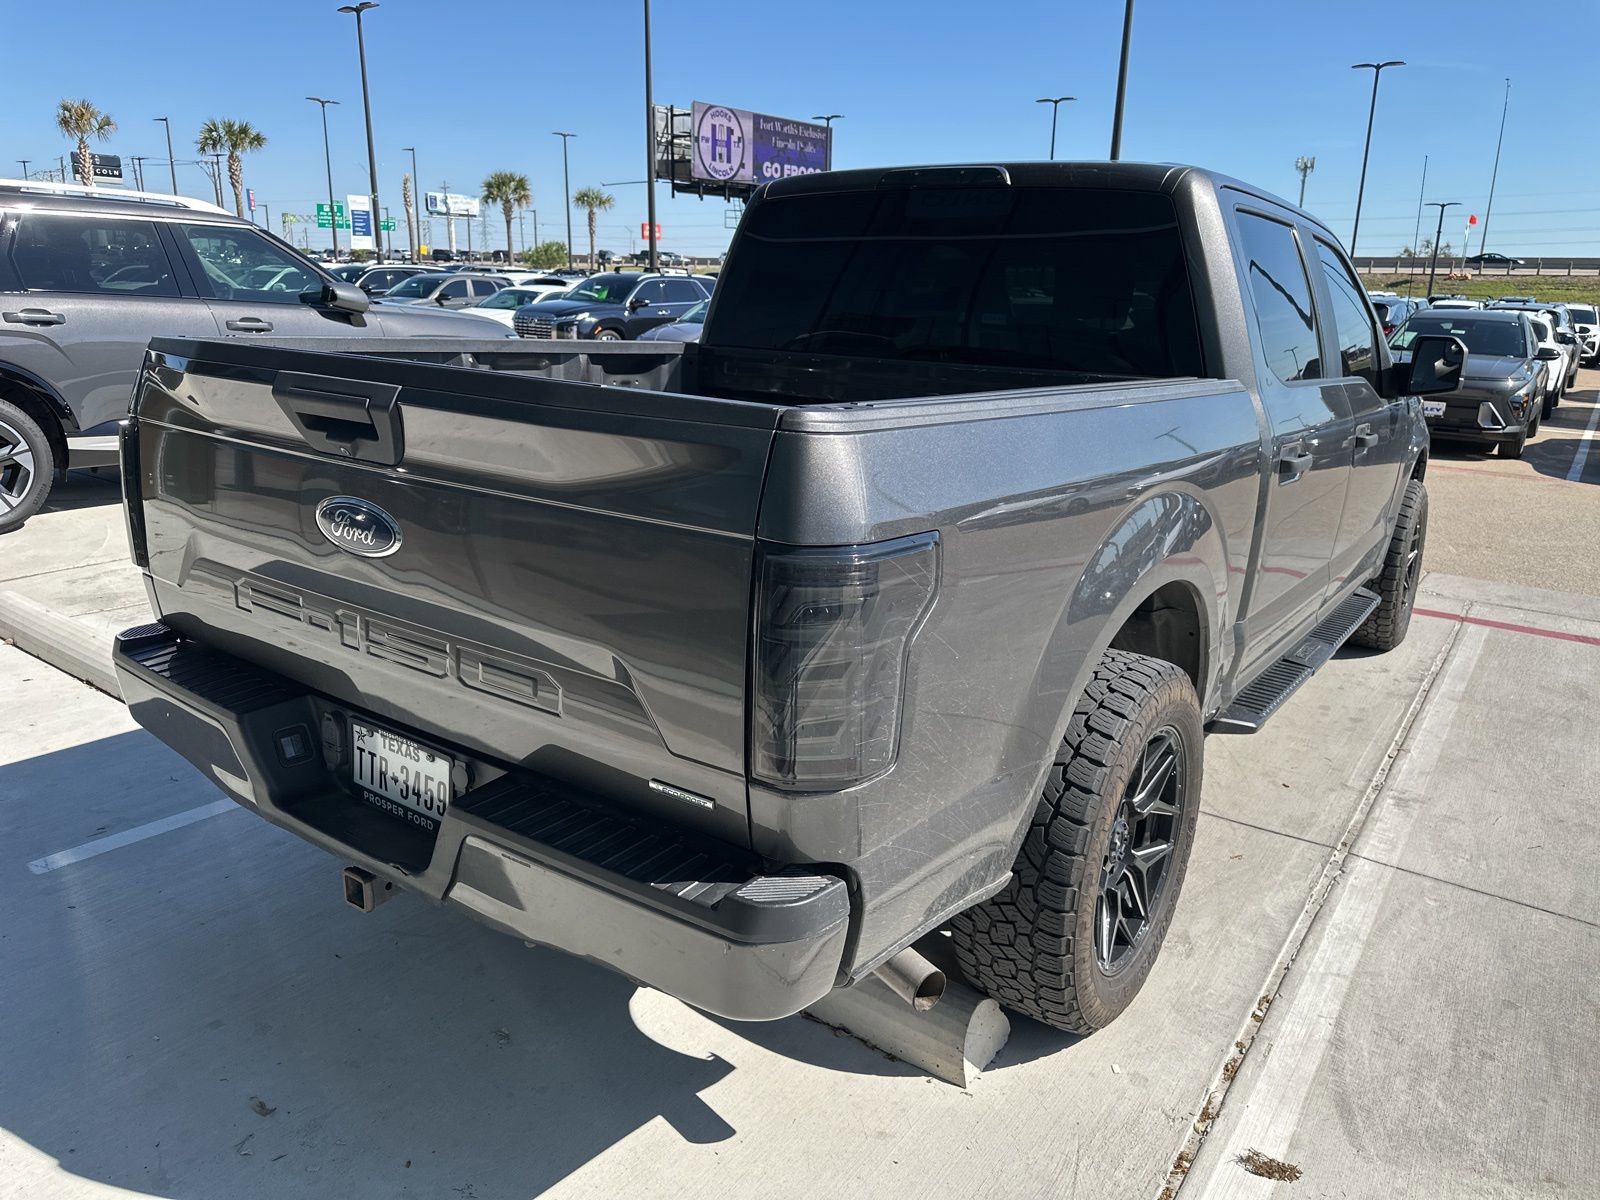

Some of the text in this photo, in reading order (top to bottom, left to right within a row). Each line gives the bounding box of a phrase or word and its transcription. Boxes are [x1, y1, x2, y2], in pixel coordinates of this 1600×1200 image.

[710, 110, 732, 122] HOOKS
[701, 135, 710, 144] FW
[760, 118, 774, 132] Fort
[799, 125, 827, 140] Exclusive
[771, 136, 796, 150] Lincoln
[708, 162, 734, 177] LINCOLN
[762, 161, 822, 179] GO FRO
[331, 509, 376, 545] Ford
[234, 577, 563, 718] F-150
[381, 736, 421, 763] TEXAS
[356, 745, 447, 817] TTR 3459
[363, 790, 434, 830] PROSPER FORD
